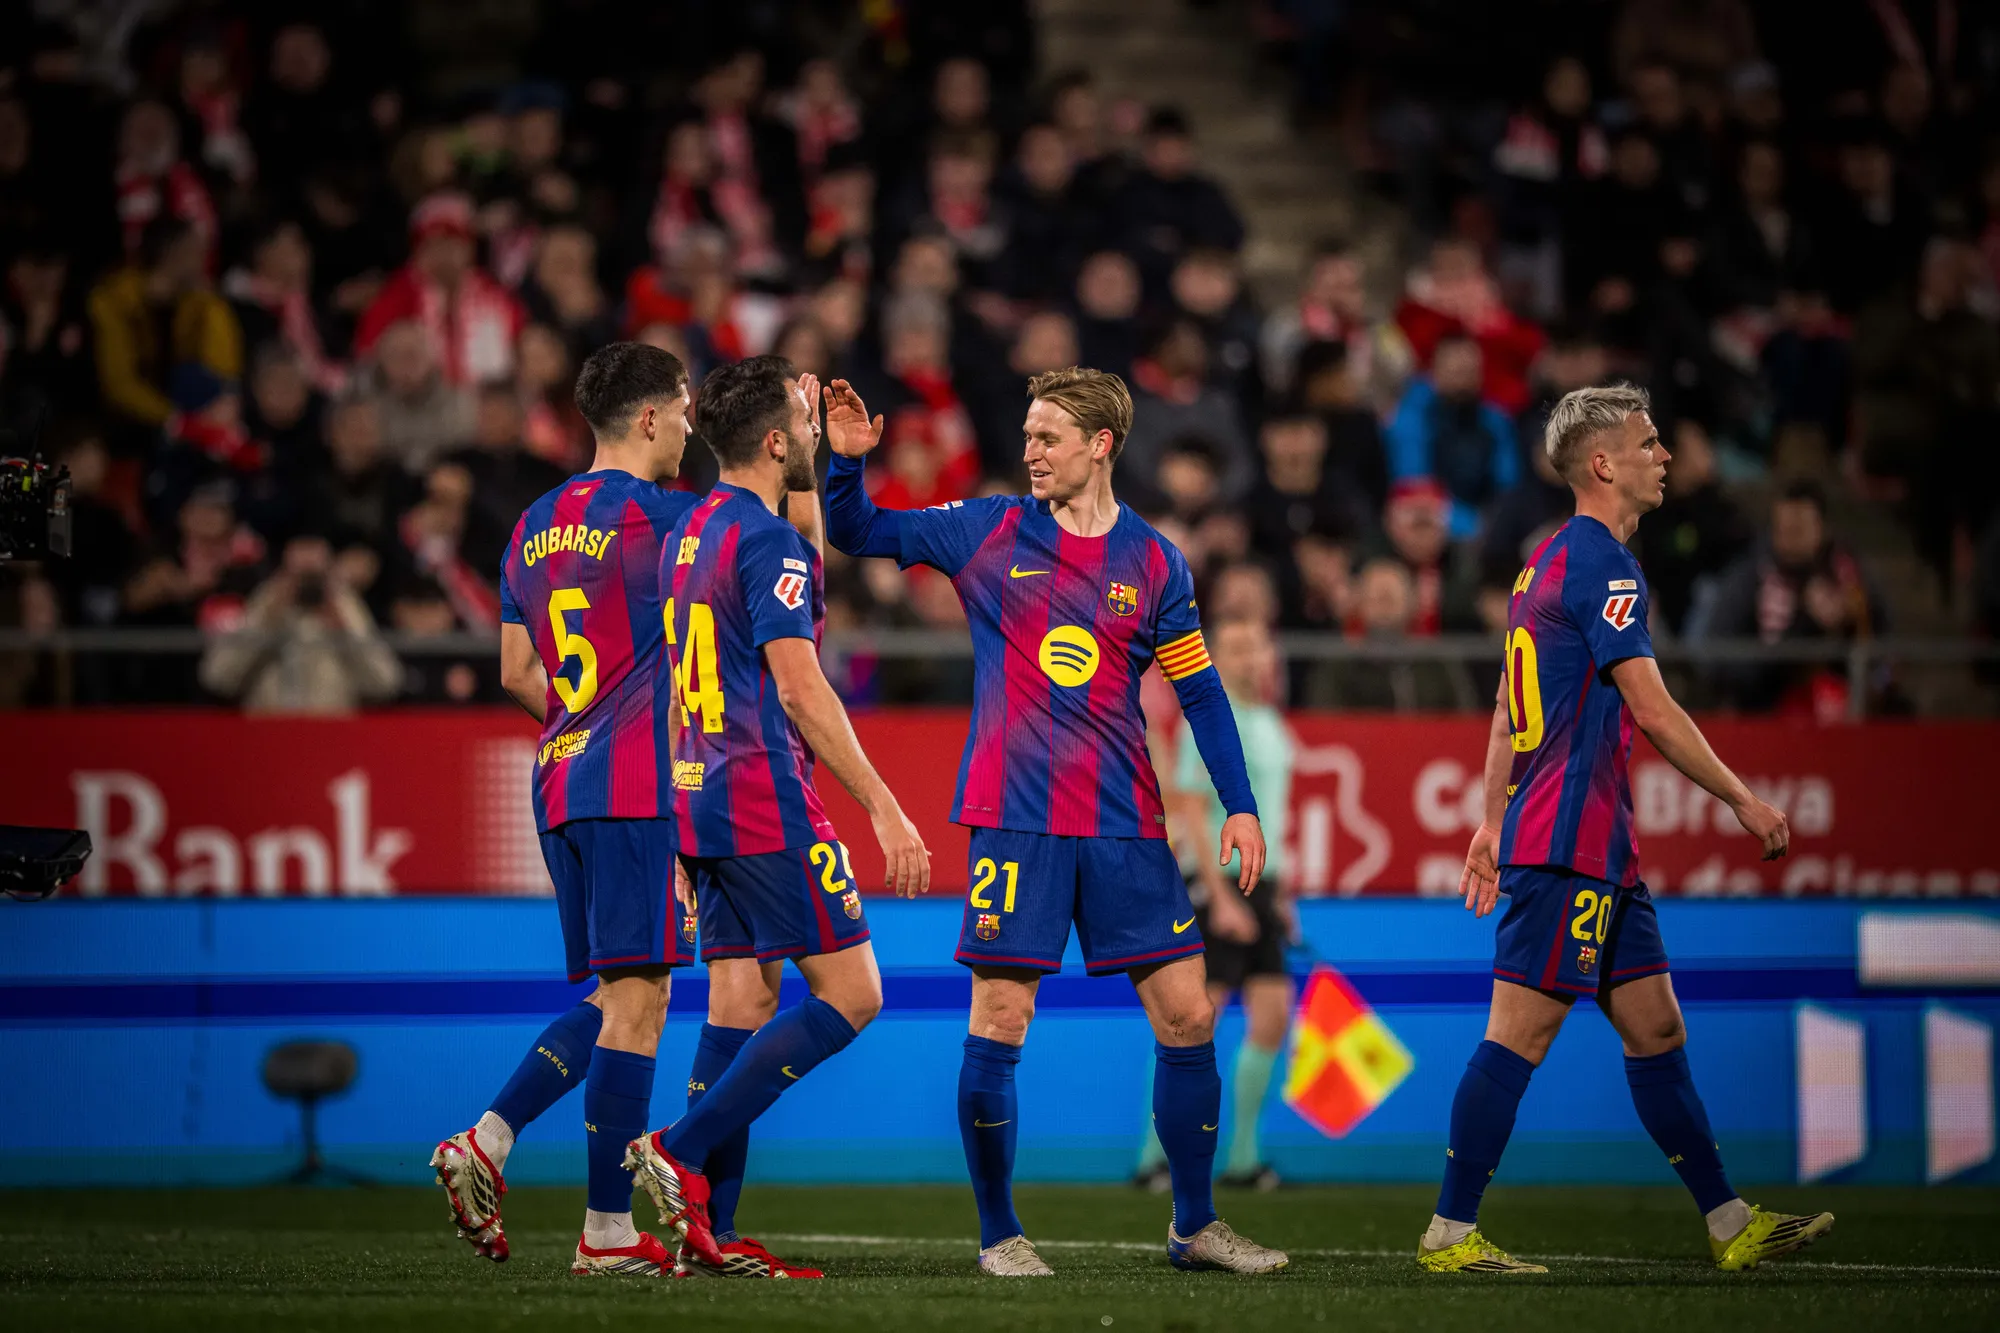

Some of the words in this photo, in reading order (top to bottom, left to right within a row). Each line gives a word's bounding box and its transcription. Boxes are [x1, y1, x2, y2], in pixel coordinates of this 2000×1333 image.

[523, 524, 618, 567] CUBARSÍ
[548, 588, 598, 713] 5
[1504, 626, 1543, 753] 0
[970, 857, 1019, 913] 21
[1571, 889, 1612, 945] 20
